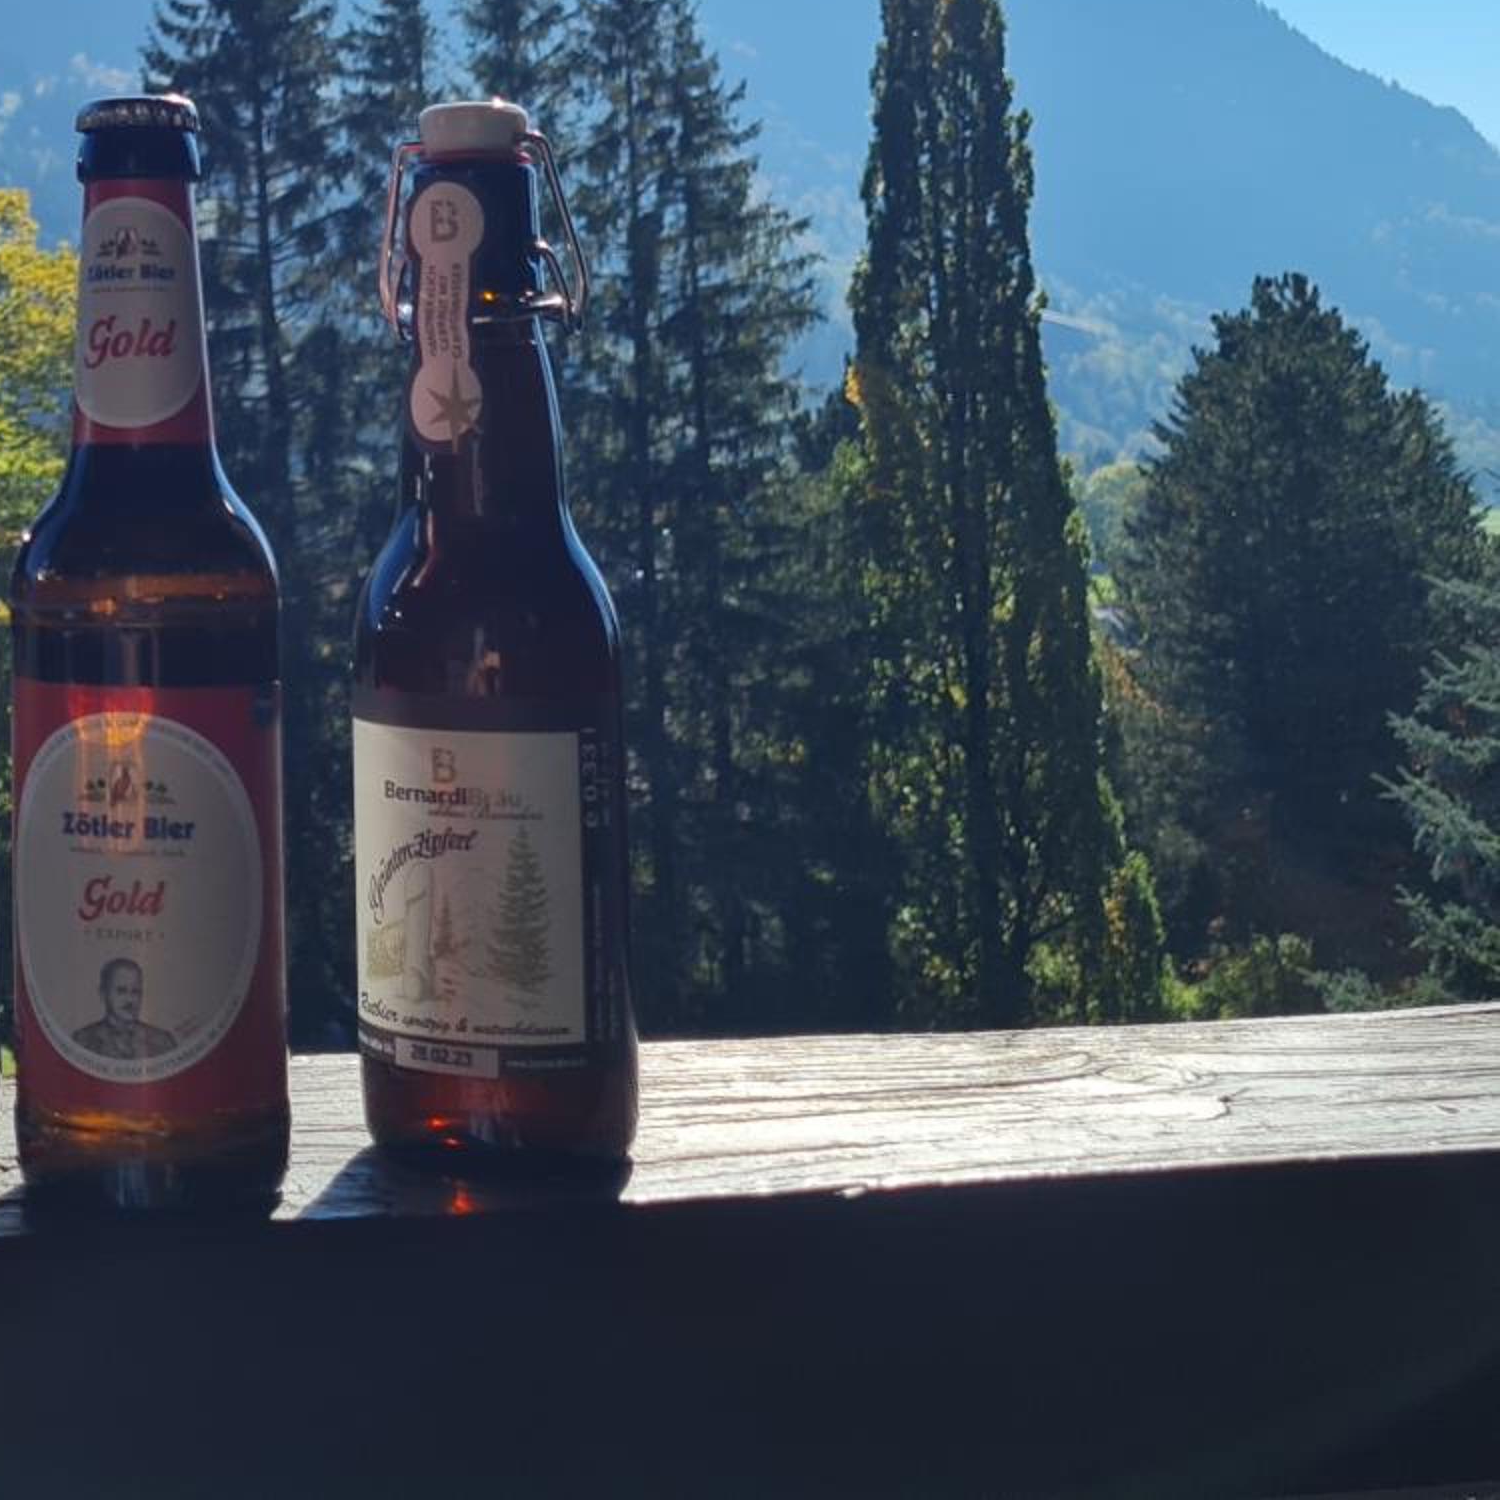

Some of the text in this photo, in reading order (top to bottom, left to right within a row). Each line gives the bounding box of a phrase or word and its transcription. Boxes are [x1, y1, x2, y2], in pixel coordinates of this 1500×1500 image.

[84, 314, 177, 370] Gold
[61, 810, 196, 841] Zötler Bier
[77, 873, 166, 922] Gold
